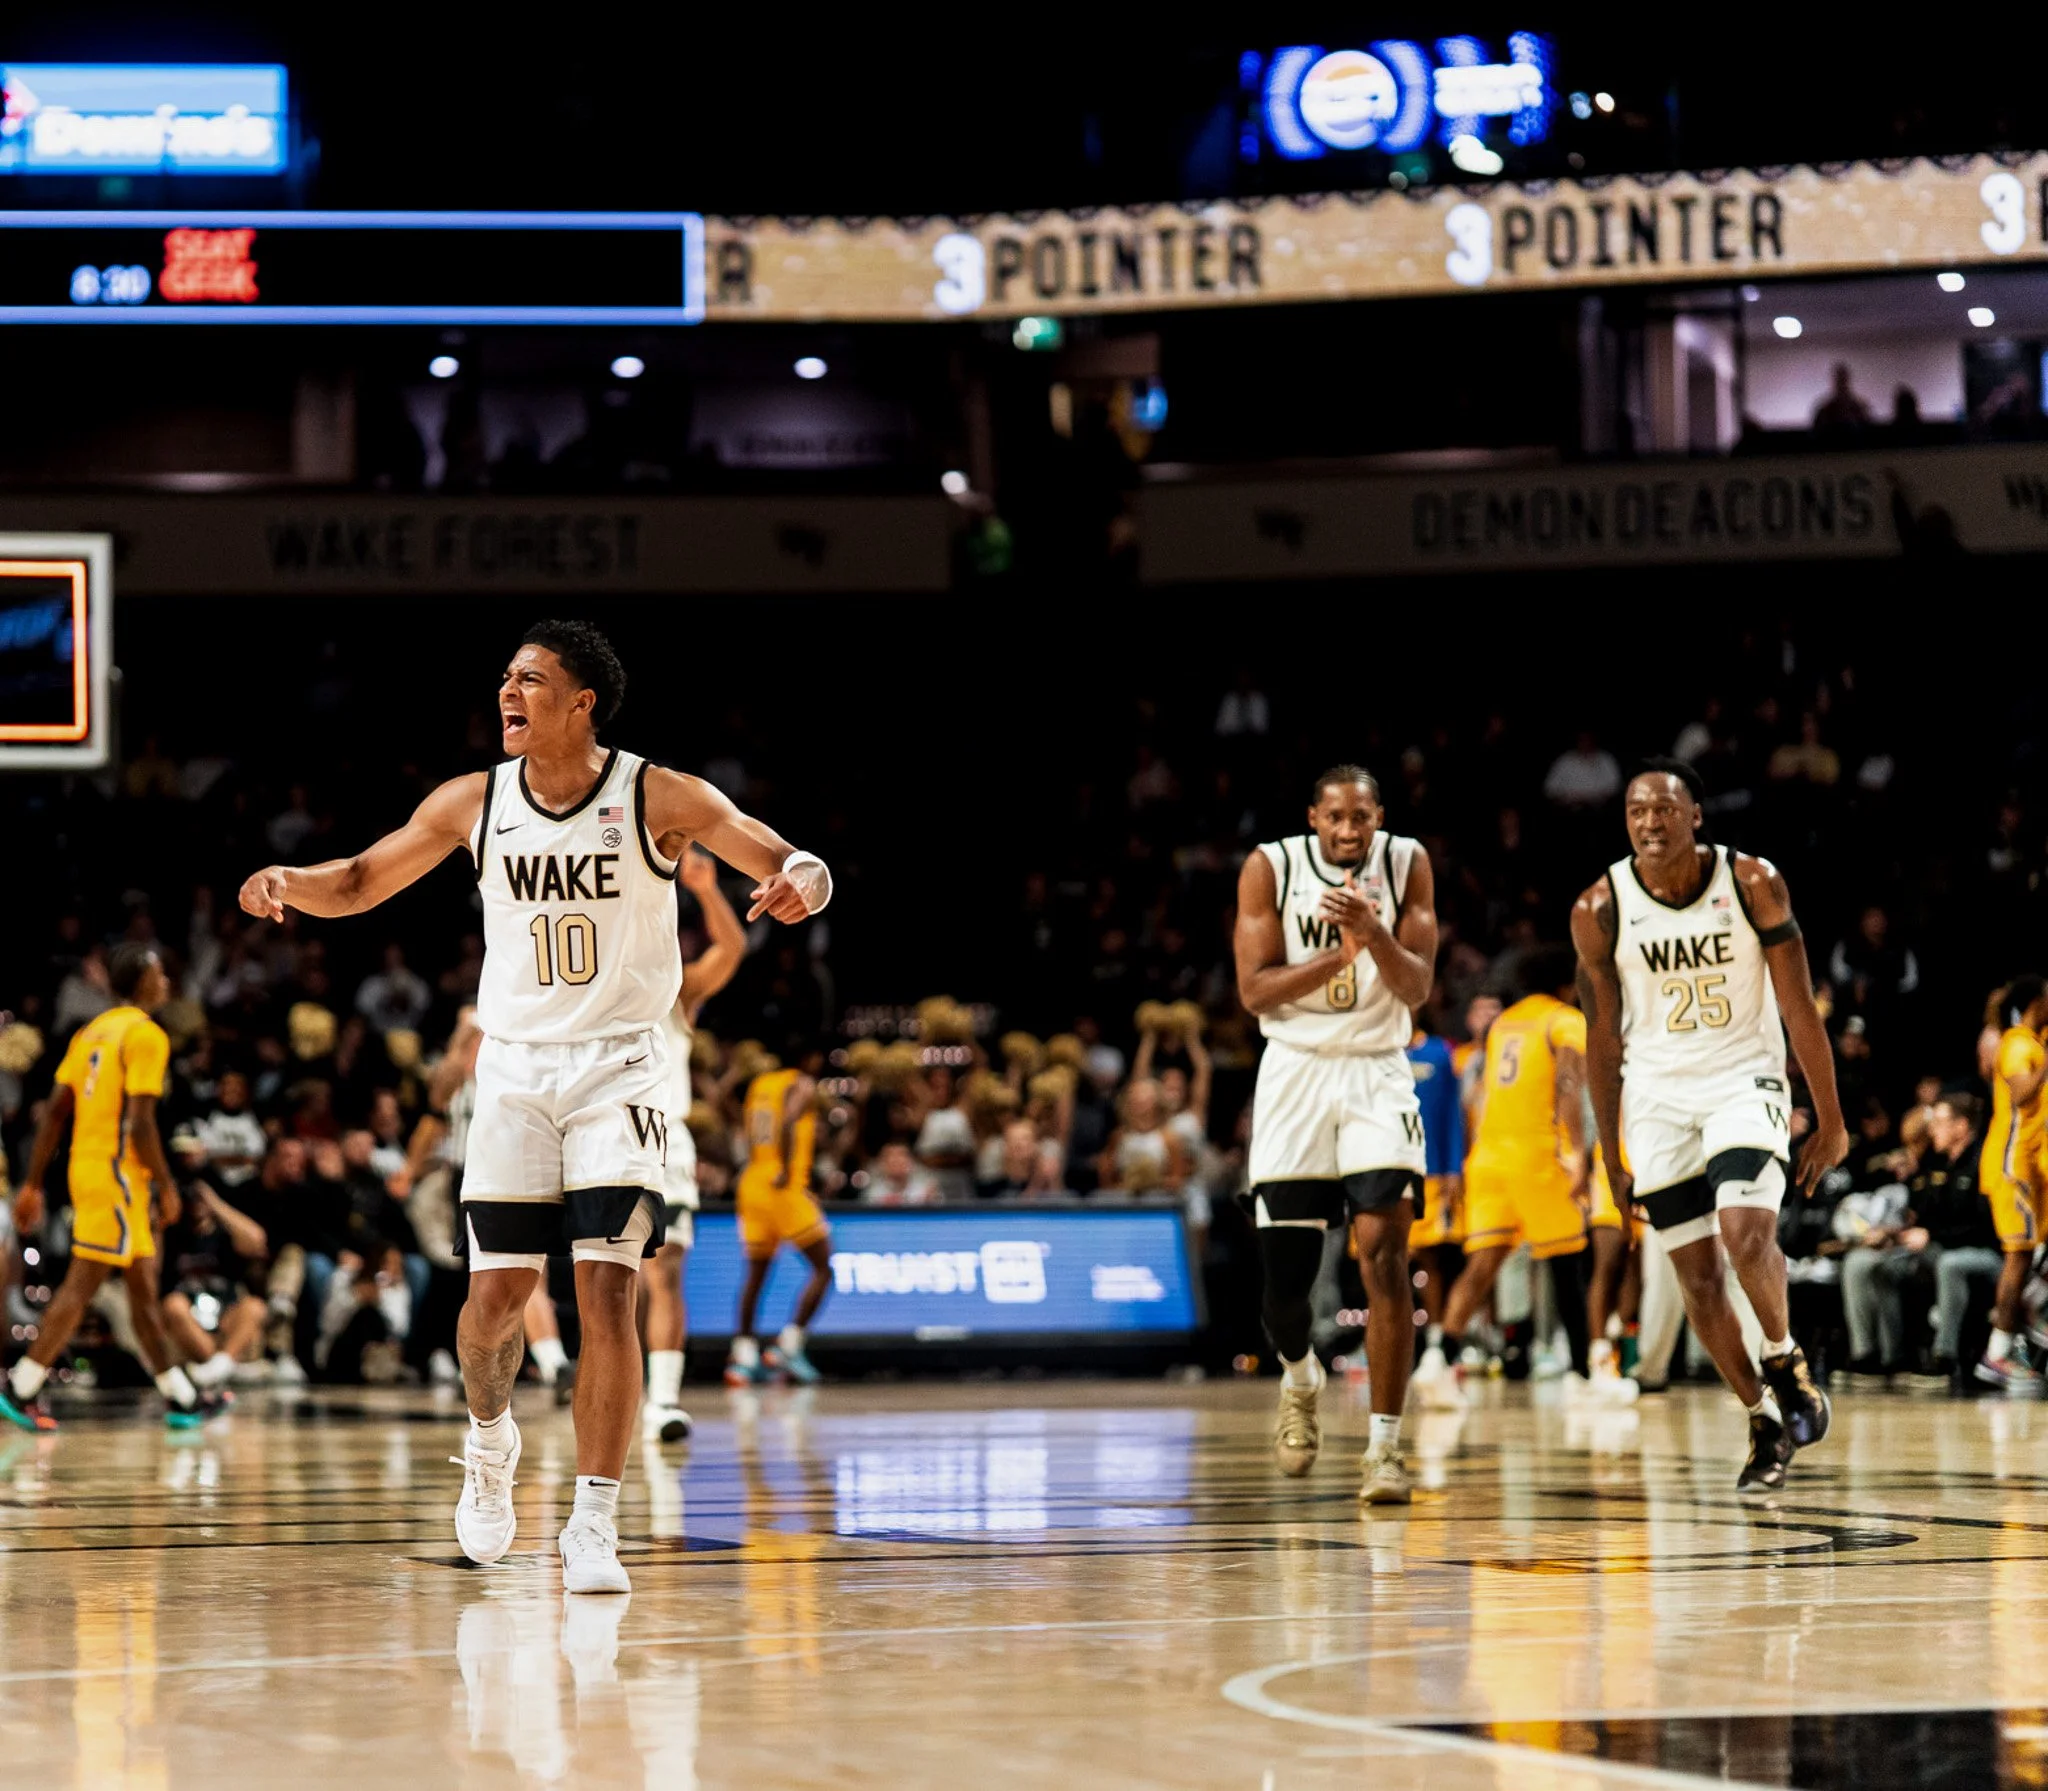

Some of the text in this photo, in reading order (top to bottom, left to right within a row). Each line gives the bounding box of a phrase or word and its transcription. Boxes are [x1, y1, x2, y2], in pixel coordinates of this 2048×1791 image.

[1444, 188, 1784, 286] 3 POINTER
[1978, 172, 2026, 255] 3
[933, 223, 1262, 315] 3 POINTER
[1611, 472, 1875, 547] DEACONS
[267, 513, 642, 579] WAKE FOREST
[503, 853, 620, 901] WAKE
[530, 913, 598, 986] 10
[1297, 912, 1345, 949] WA
[1639, 932, 1734, 973] WAKE
[1327, 961, 1358, 1010] 8
[1661, 973, 1732, 1033] 25
[1498, 1035, 1521, 1087] 5
